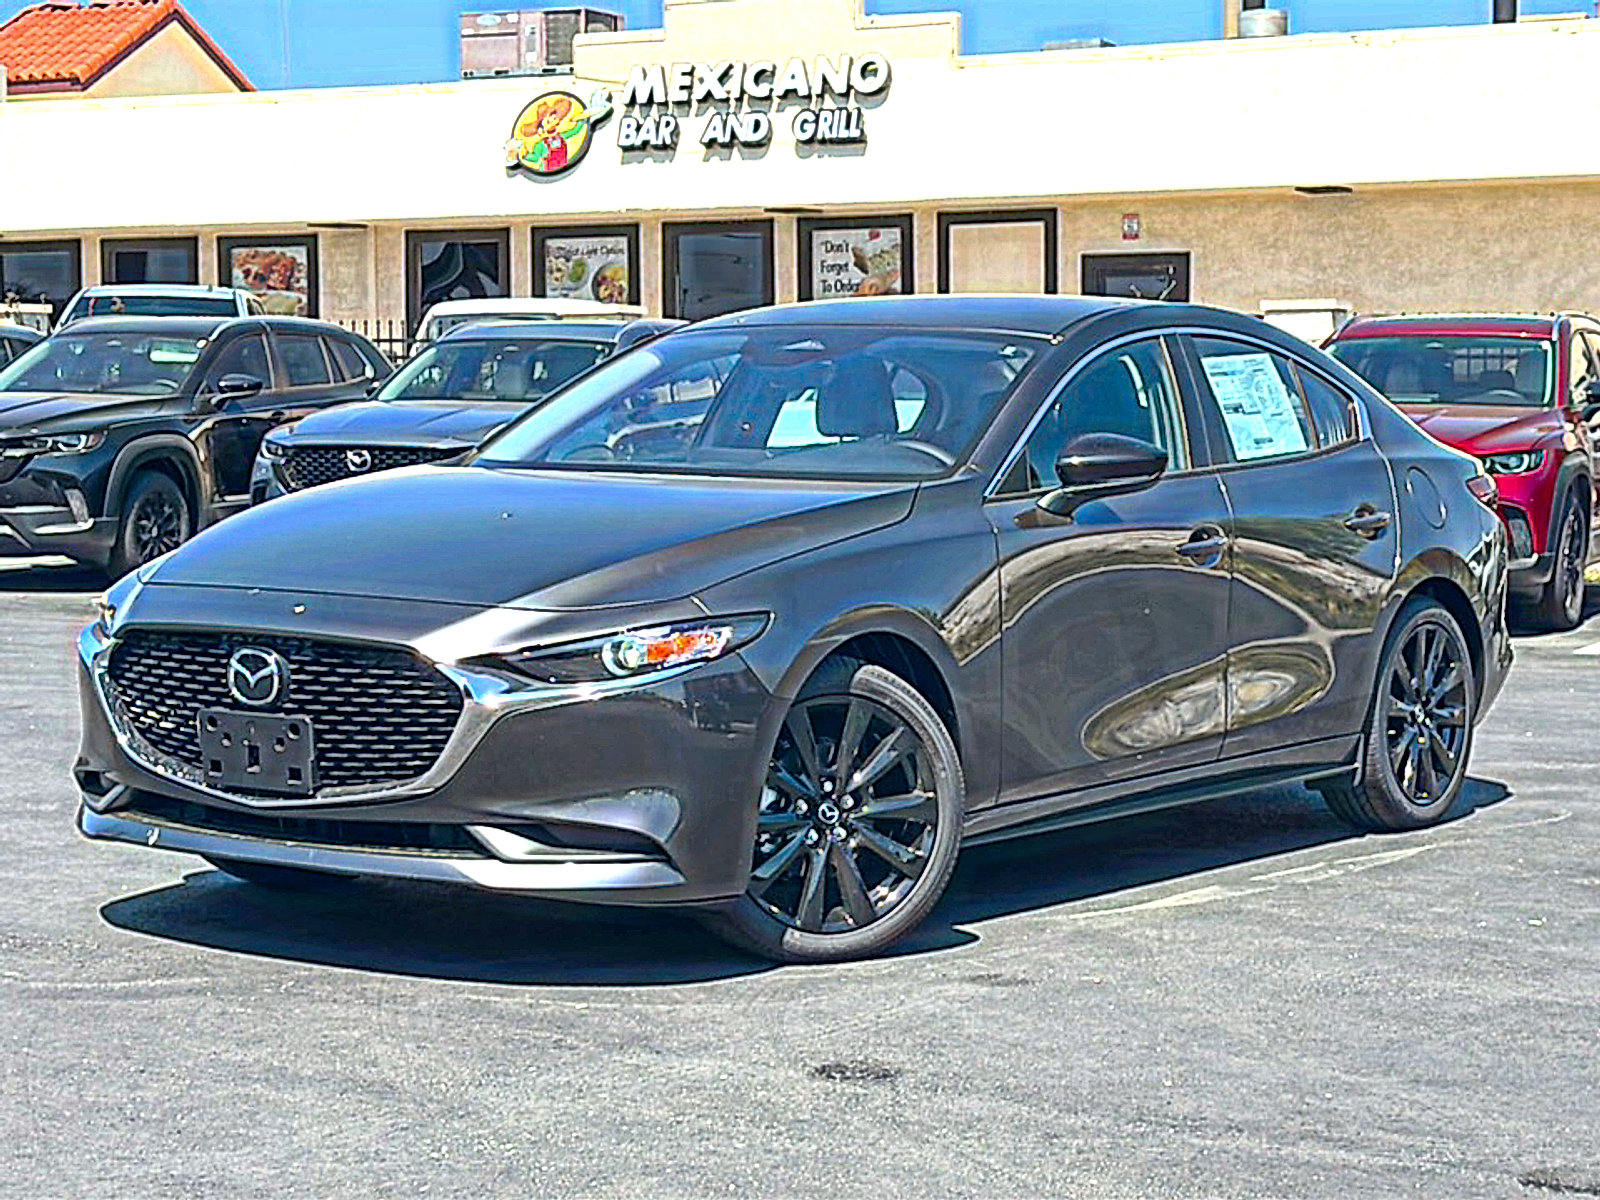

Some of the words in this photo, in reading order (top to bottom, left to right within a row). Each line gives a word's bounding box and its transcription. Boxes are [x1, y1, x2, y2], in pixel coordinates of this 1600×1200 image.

[623, 53, 890, 106] MEXICANO
[617, 114, 678, 147] BAR
[700, 111, 771, 145] AND
[793, 107, 863, 141] GRILL
[820, 260, 849, 275] Forget
[821, 280, 833, 293] To
